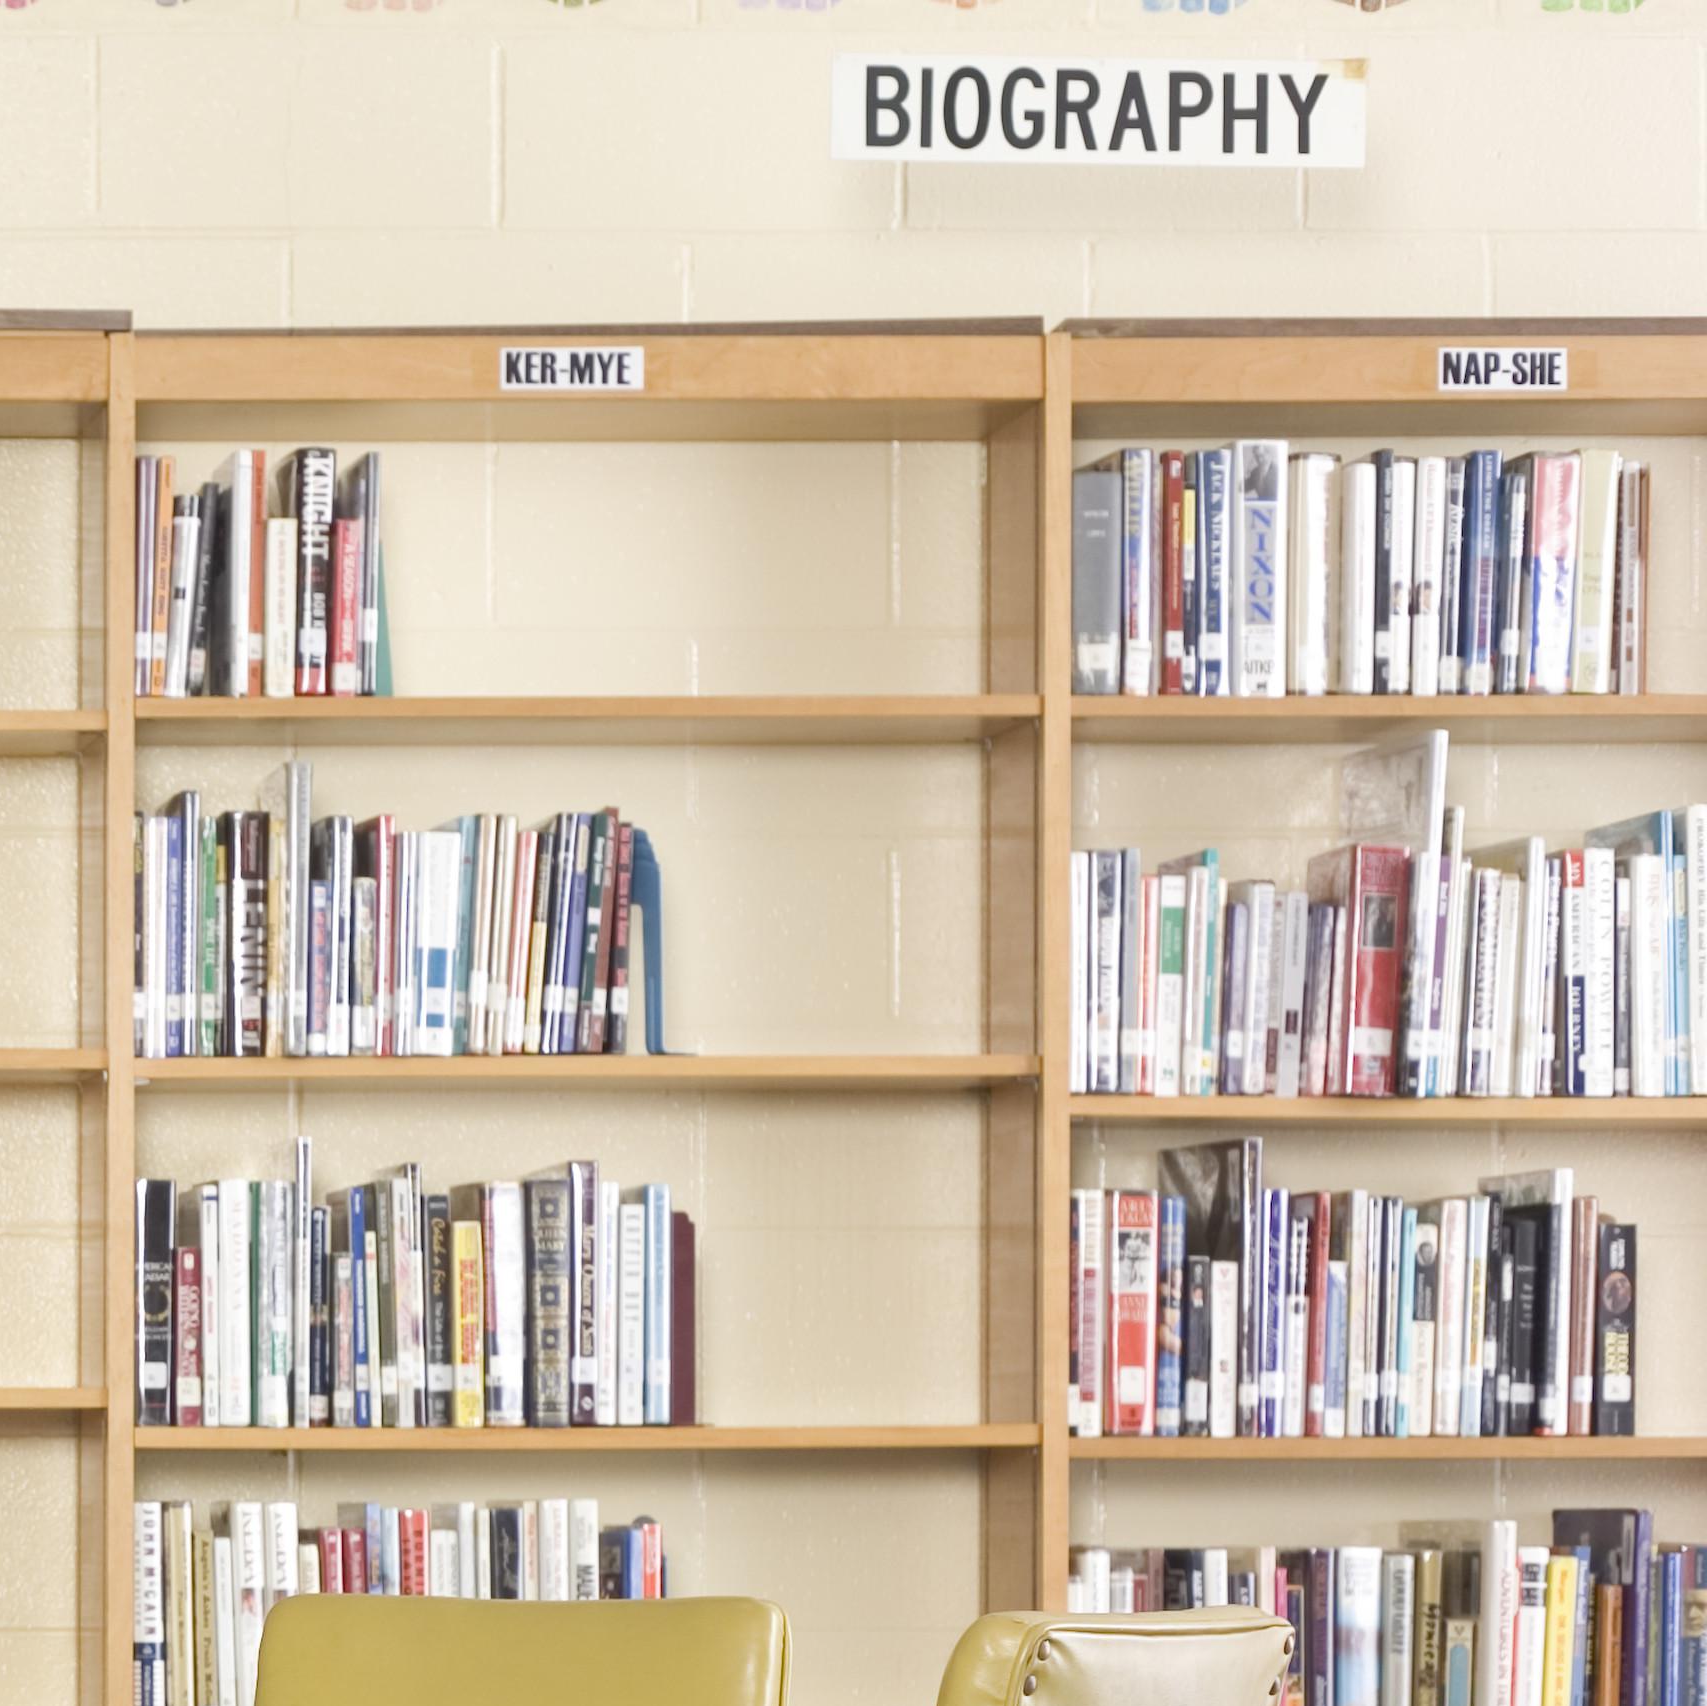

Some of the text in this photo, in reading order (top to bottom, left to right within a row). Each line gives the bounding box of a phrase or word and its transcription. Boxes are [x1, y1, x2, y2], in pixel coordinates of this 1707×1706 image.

[866, 64, 1329, 155] BIOGRAPHY
[505, 351, 632, 385] KER-MYE
[1442, 351, 1562, 385] NAP-SHE
[301, 455, 331, 560] KNIGHT
[1208, 461, 1225, 591] JACK NICKLAUS
[1248, 508, 1274, 623] NIXON
[239, 880, 264, 994] LENIN
